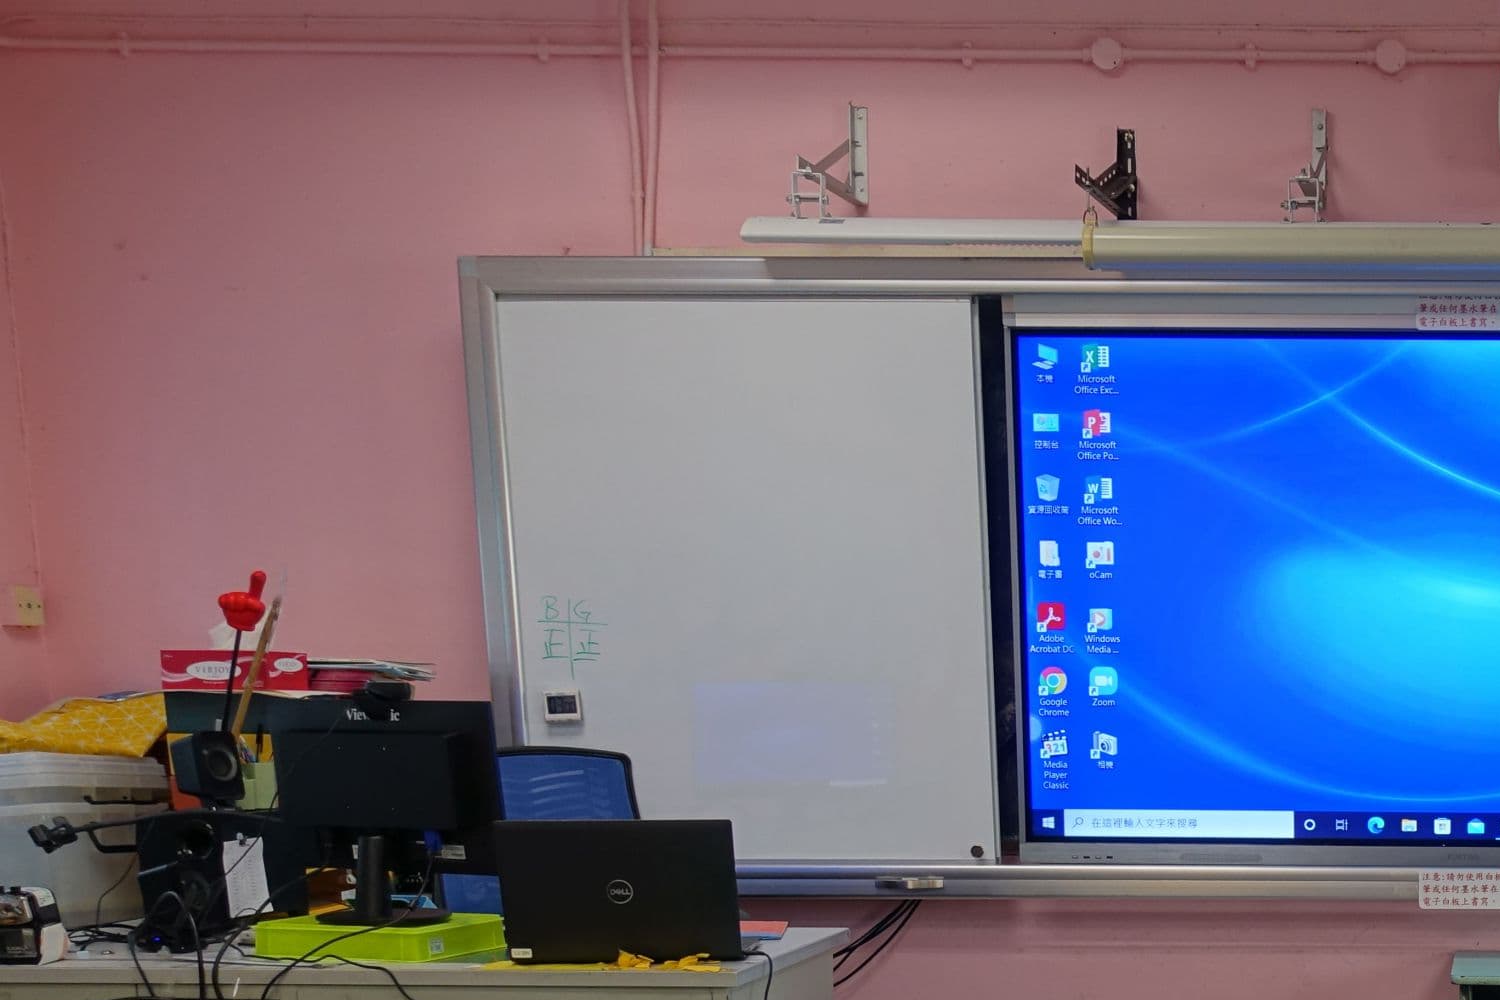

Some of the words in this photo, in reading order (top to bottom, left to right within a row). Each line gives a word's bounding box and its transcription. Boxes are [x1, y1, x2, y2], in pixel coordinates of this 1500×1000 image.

[1078, 375, 1115, 384] Microsoft
[1074, 386, 1098, 394] Office
[1079, 441, 1116, 449] Microsoft
[1077, 452, 1101, 460] Office
[1081, 506, 1118, 515] Microsoft
[1078, 517, 1101, 525] Office
[1089, 571, 1112, 579] oCam
[542, 595, 559, 619] B
[1039, 635, 1064, 643] Adobe
[1084, 635, 1120, 643] Windows
[1030, 645, 1058, 653] Acrobat
[1059, 645, 1074, 653] DC
[1040, 698, 1068, 707] Google
[1092, 698, 1115, 706] Zoom
[1038, 708, 1069, 717] Chrome
[1044, 760, 1068, 768] Media
[1044, 771, 1068, 780] Player
[1043, 781, 1069, 789] Classic
